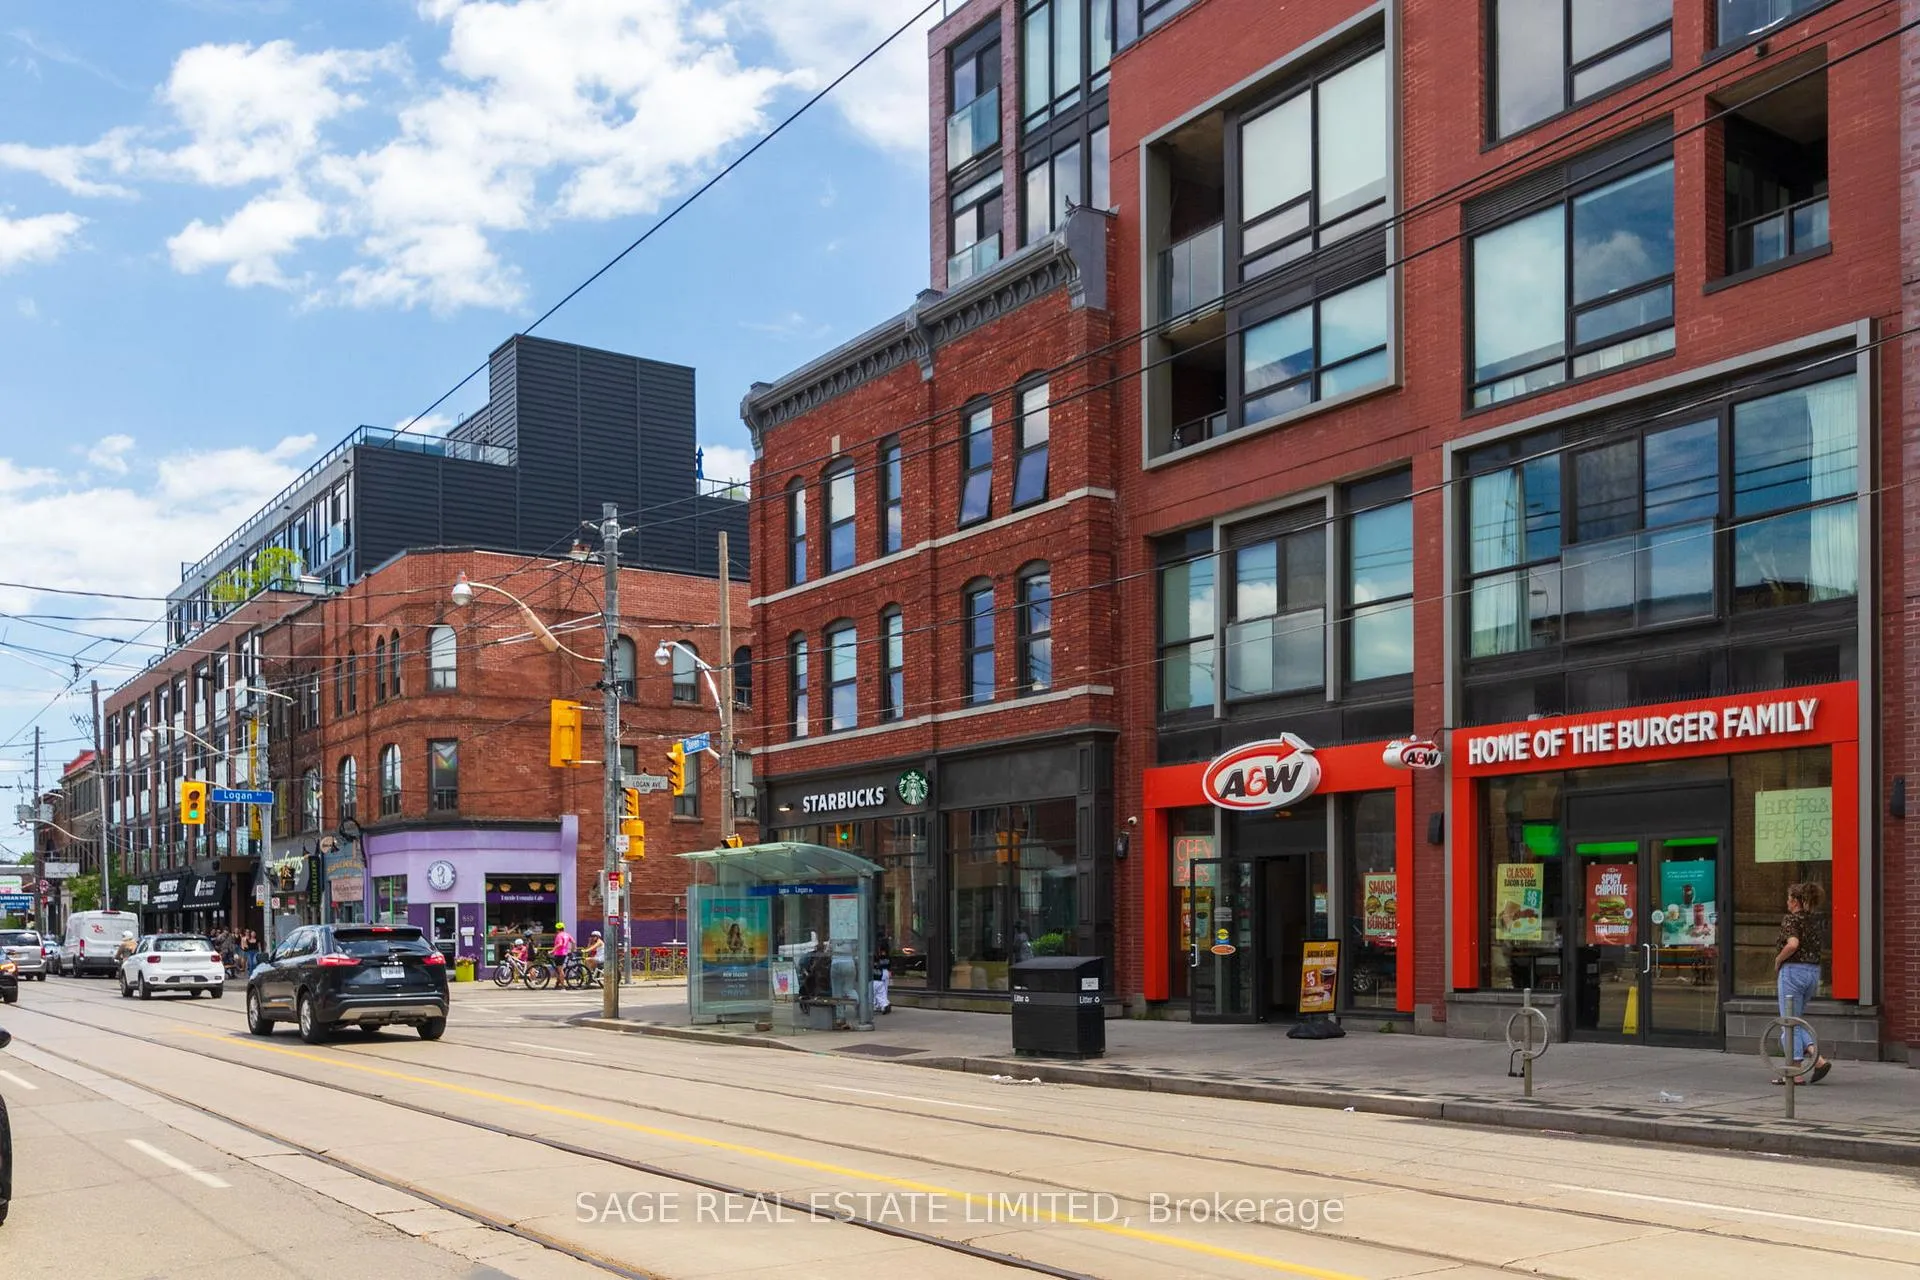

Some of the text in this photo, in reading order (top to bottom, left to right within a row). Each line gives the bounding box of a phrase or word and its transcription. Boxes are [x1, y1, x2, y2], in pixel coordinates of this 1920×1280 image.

[1468, 698, 1818, 766] HOME OF THE BURGER FAMILY
[1406, 752, 1438, 766] A&W
[632, 780, 650, 788] LOGAN
[1219, 760, 1303, 799] A&W
[223, 790, 253, 802] Logan
[802, 786, 885, 814] STARBUCKS
[1176, 839, 1212, 861] OPEN
[1506, 868, 1535, 879] CLASSIC
[1601, 873, 1622, 885] SPICY
[1369, 880, 1396, 895] SMASH
[1595, 884, 1628, 896] CHIPOTLE
